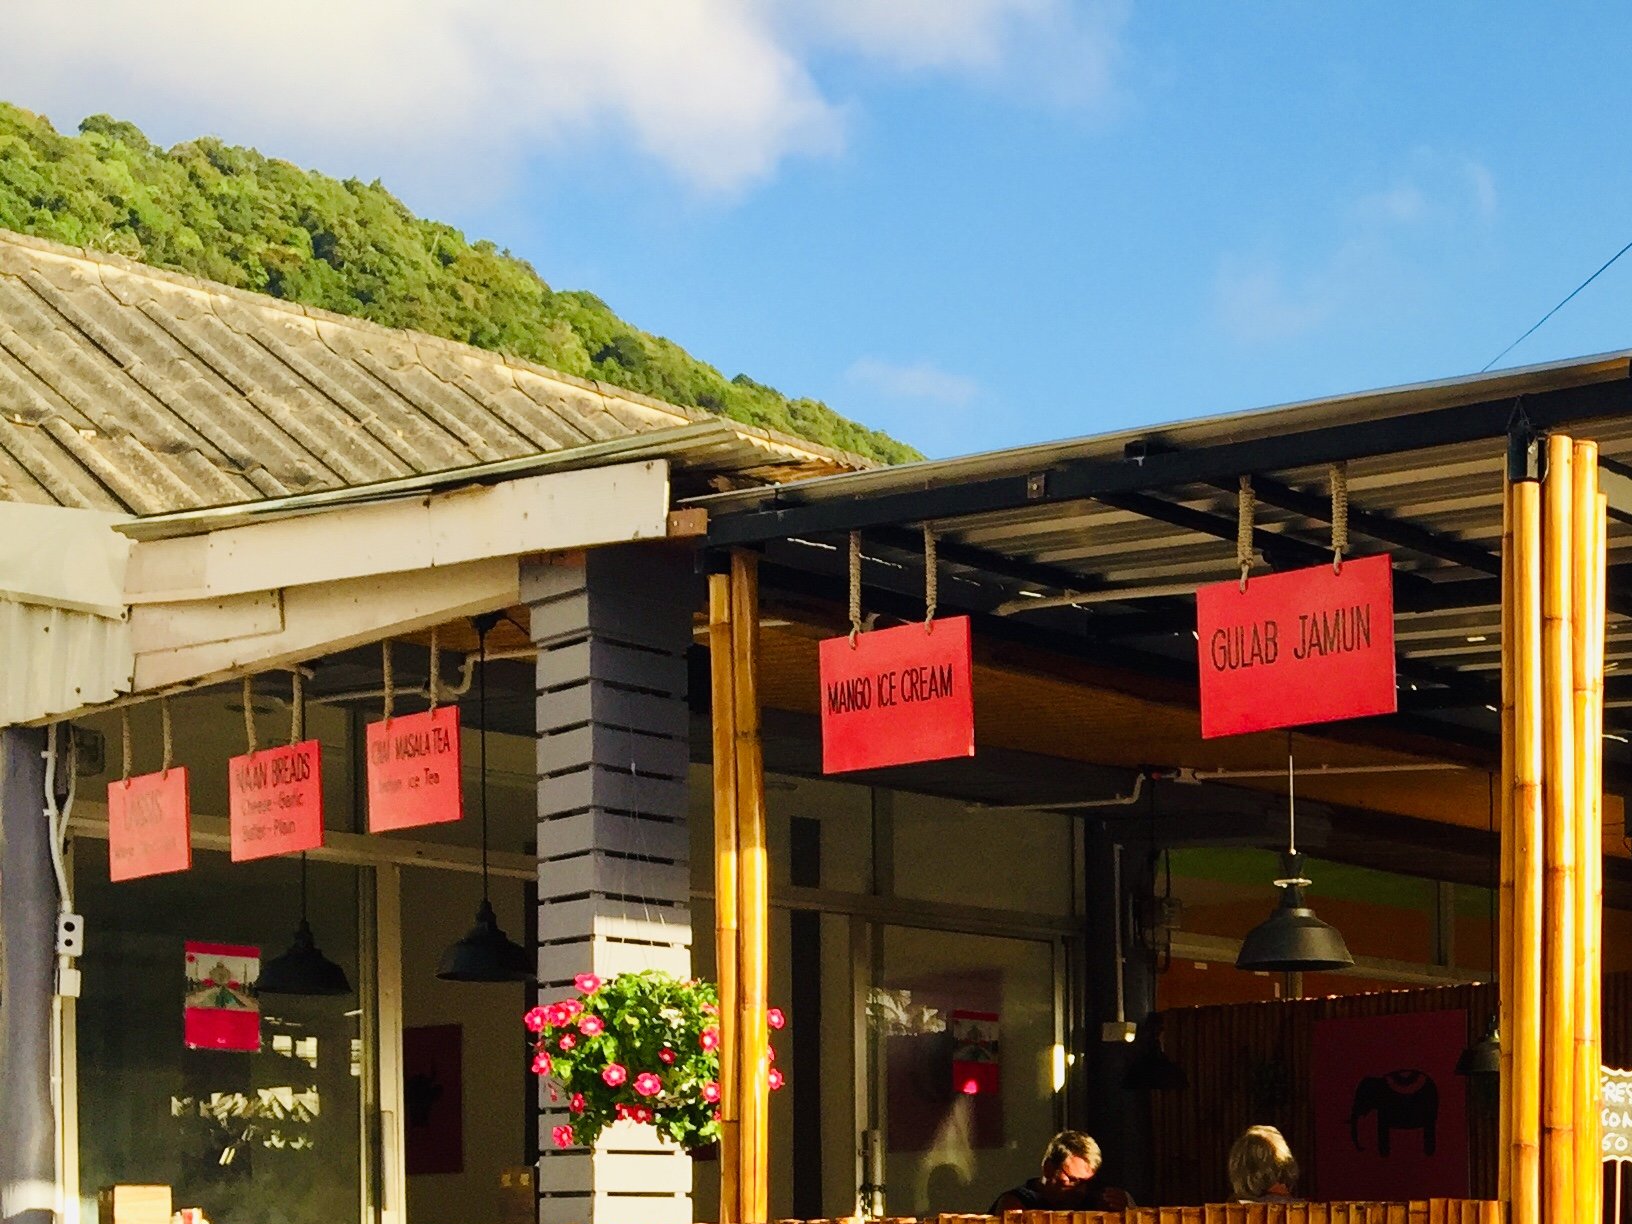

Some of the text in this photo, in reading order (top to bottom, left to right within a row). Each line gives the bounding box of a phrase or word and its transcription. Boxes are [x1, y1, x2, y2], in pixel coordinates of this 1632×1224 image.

[1210, 603, 1374, 672] GULAB JAMUN
[827, 662, 954, 716] MANGO ICE CREAM
[395, 730, 430, 761] MASALA
[431, 725, 451, 754] TEA
[271, 752, 311, 788] BREADS
